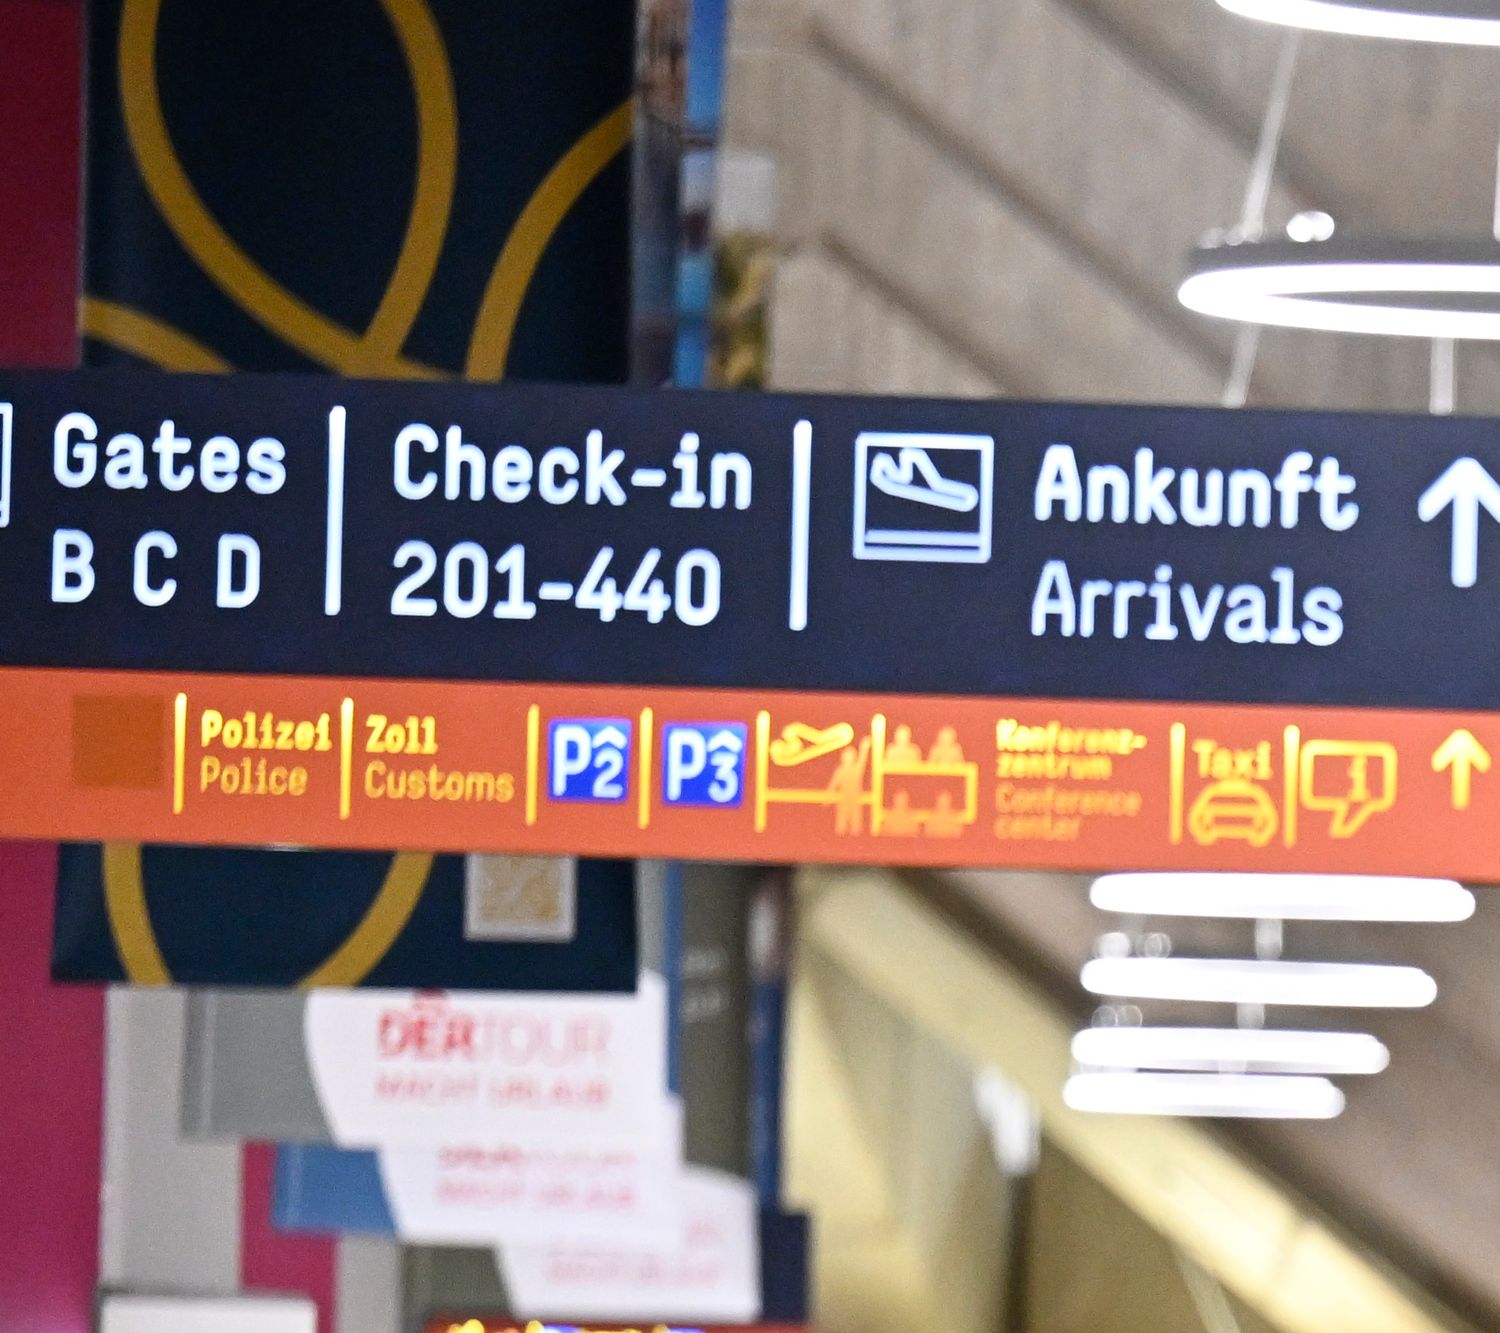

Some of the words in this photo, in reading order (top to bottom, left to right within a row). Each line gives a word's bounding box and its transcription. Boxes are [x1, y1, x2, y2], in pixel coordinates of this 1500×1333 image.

[53, 412, 286, 495] Gates
[394, 424, 752, 510] Check-in
[1034, 444, 1359, 531] Ankunft
[51, 529, 96, 603] B
[133, 530, 178, 607] C
[216, 533, 261, 608] D
[390, 538, 722, 626] 201-440
[1030, 559, 1345, 646] Arrivals
[201, 709, 332, 752] Polizei
[366, 714, 438, 755] Zoll
[552, 724, 625, 799] P2
[666, 728, 741, 804] P3
[1192, 737, 1275, 780] Taxi
[200, 756, 308, 797] Police
[363, 760, 515, 803] Customs
